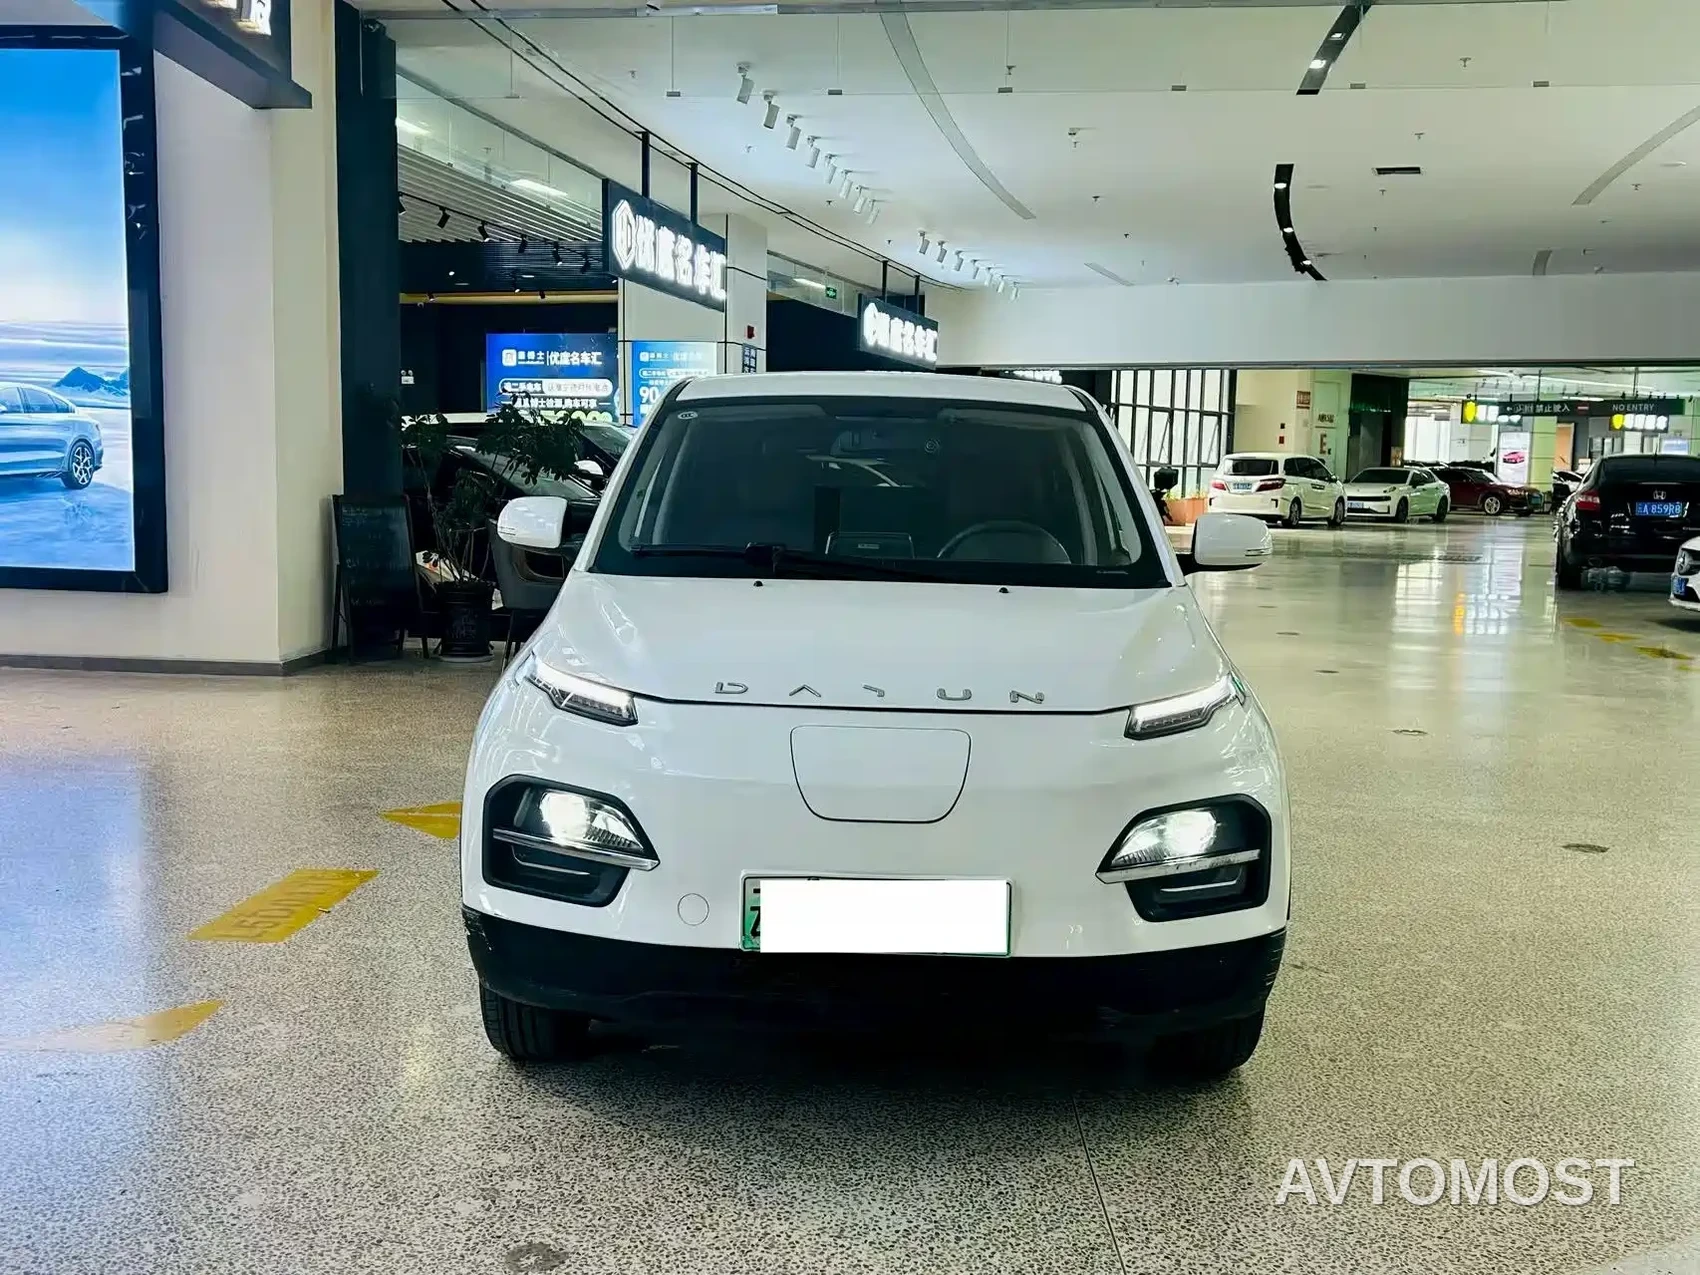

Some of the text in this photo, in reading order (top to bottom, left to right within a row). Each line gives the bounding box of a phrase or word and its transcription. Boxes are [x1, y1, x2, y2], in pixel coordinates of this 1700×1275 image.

[1612, 403, 1655, 412] NO ENTRY
[714, 680, 1046, 705] DAYUN
